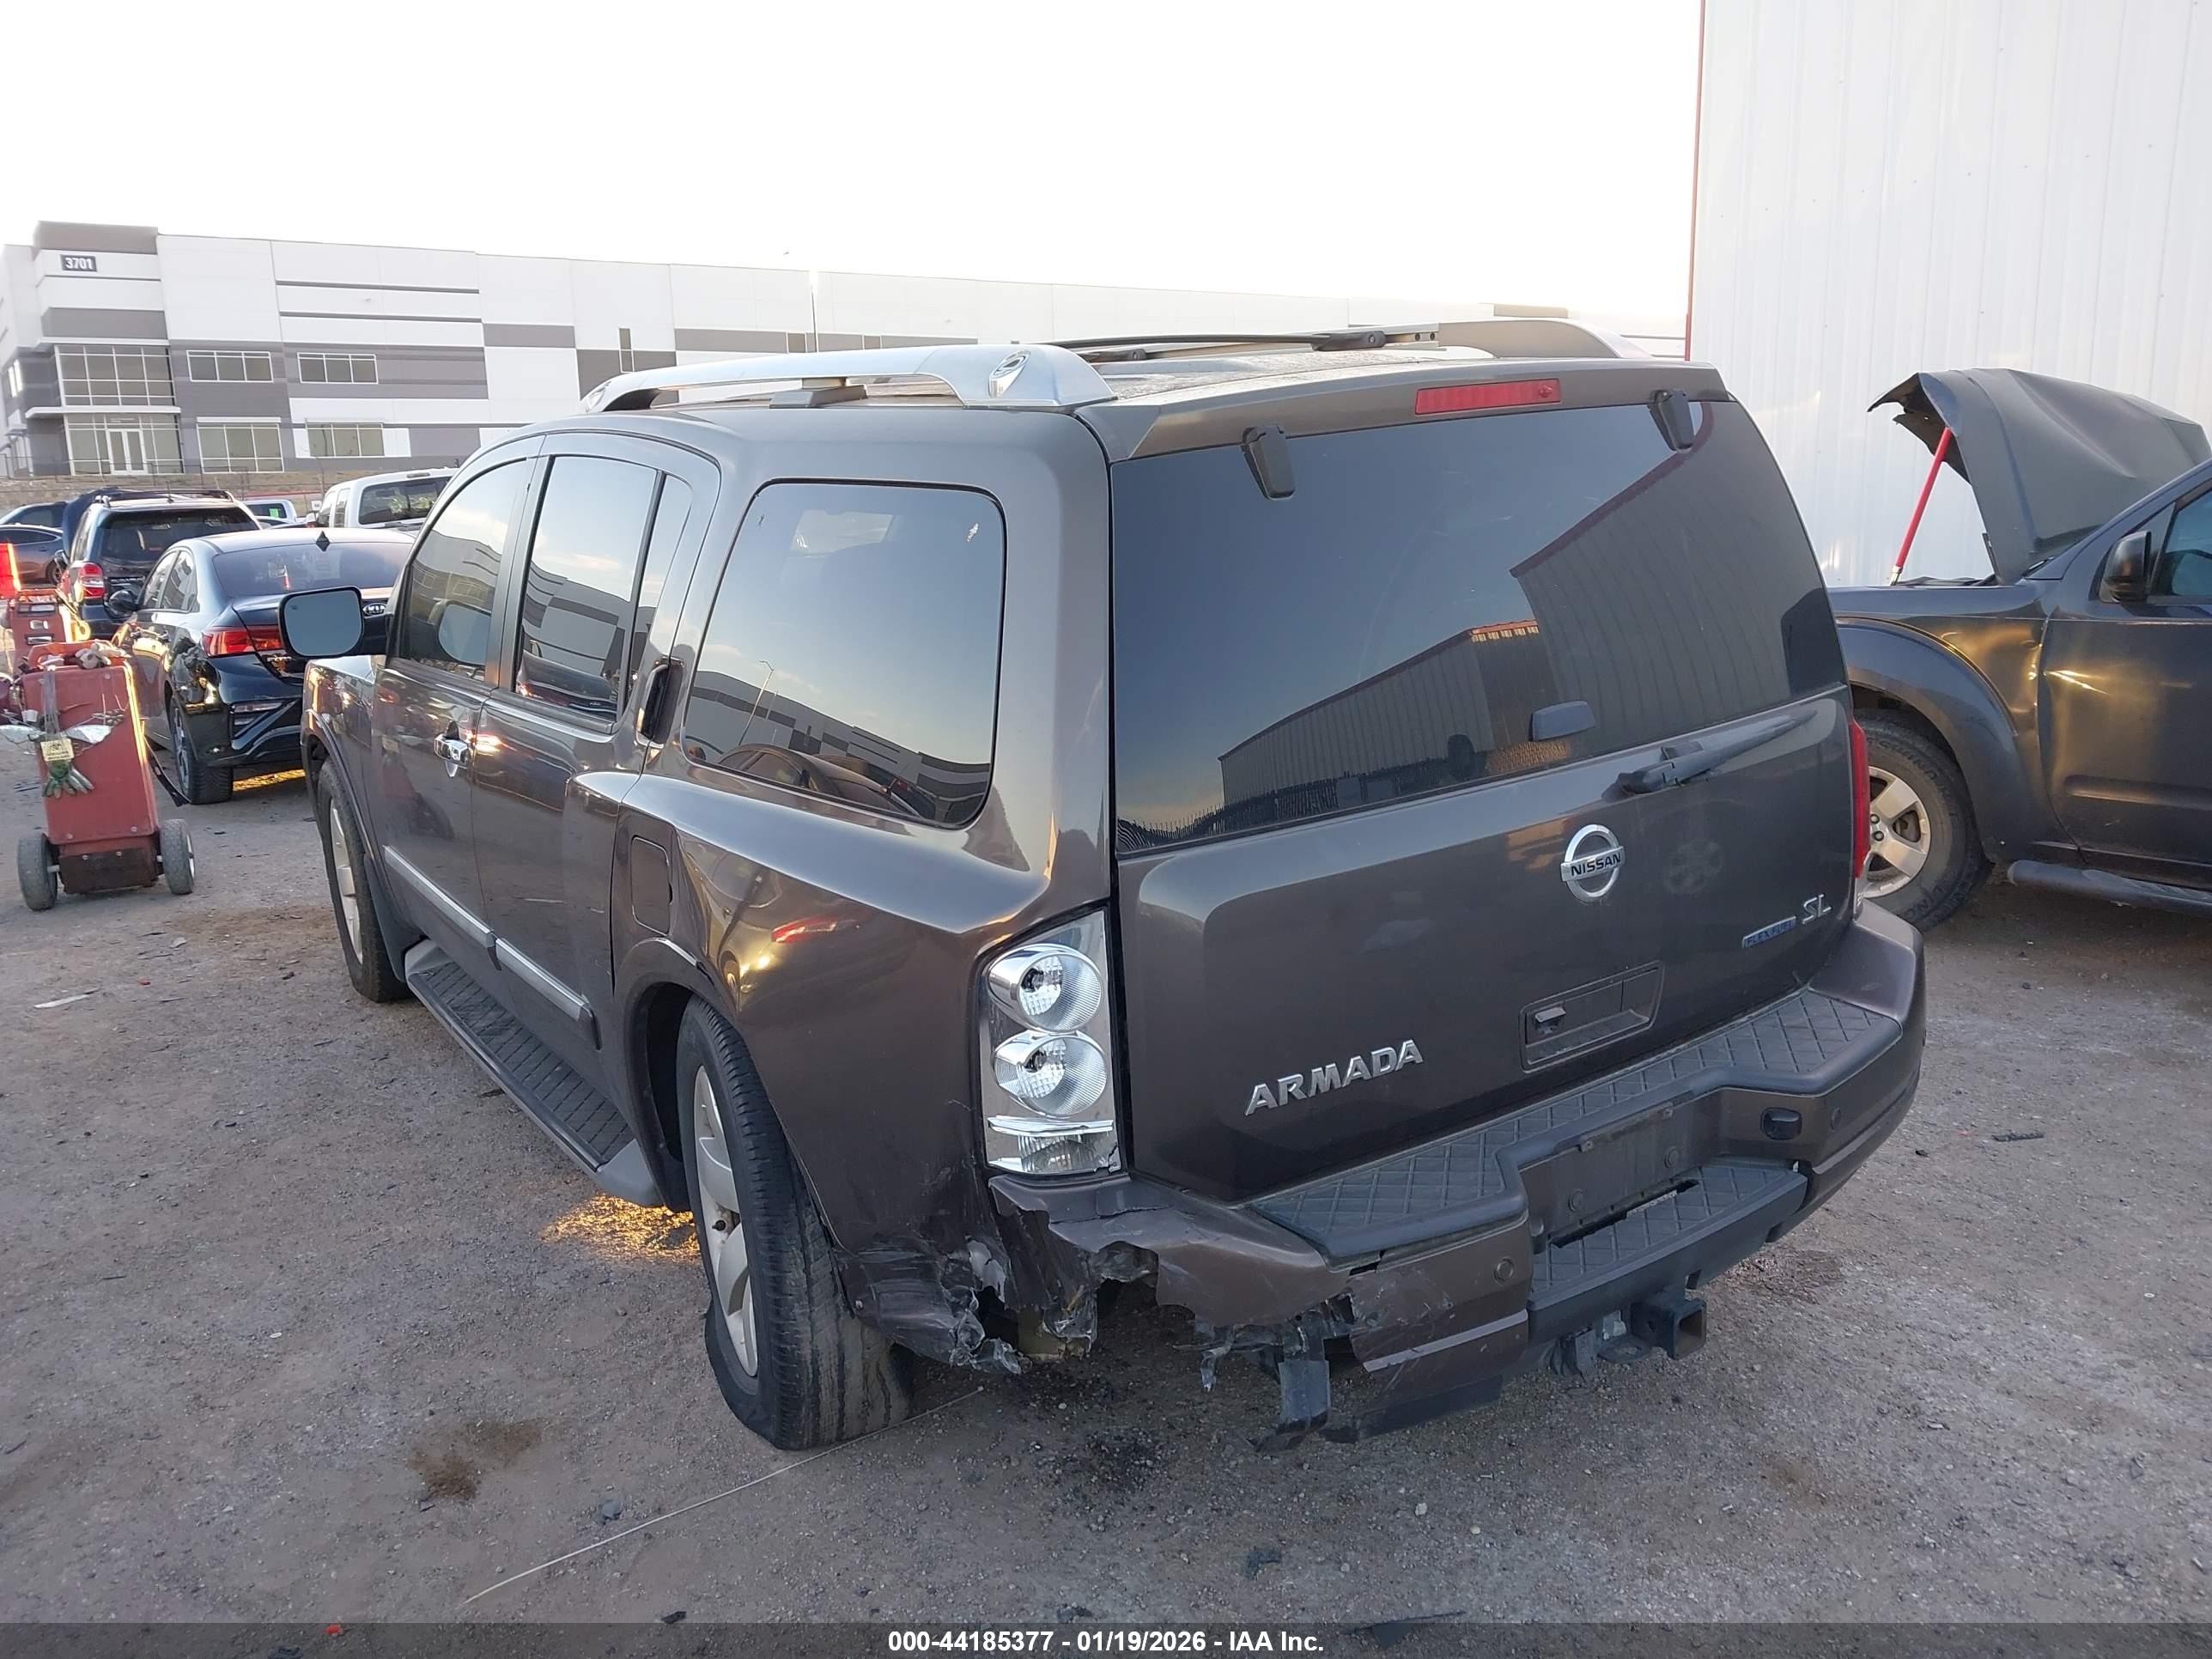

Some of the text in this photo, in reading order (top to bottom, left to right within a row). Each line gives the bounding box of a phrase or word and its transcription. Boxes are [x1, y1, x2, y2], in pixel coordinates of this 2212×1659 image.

[65, 257, 93, 270] 3701
[1571, 852, 1621, 877] NISSAN
[1802, 893, 1832, 925] SL
[1244, 1038, 1424, 1117] ARMADA
